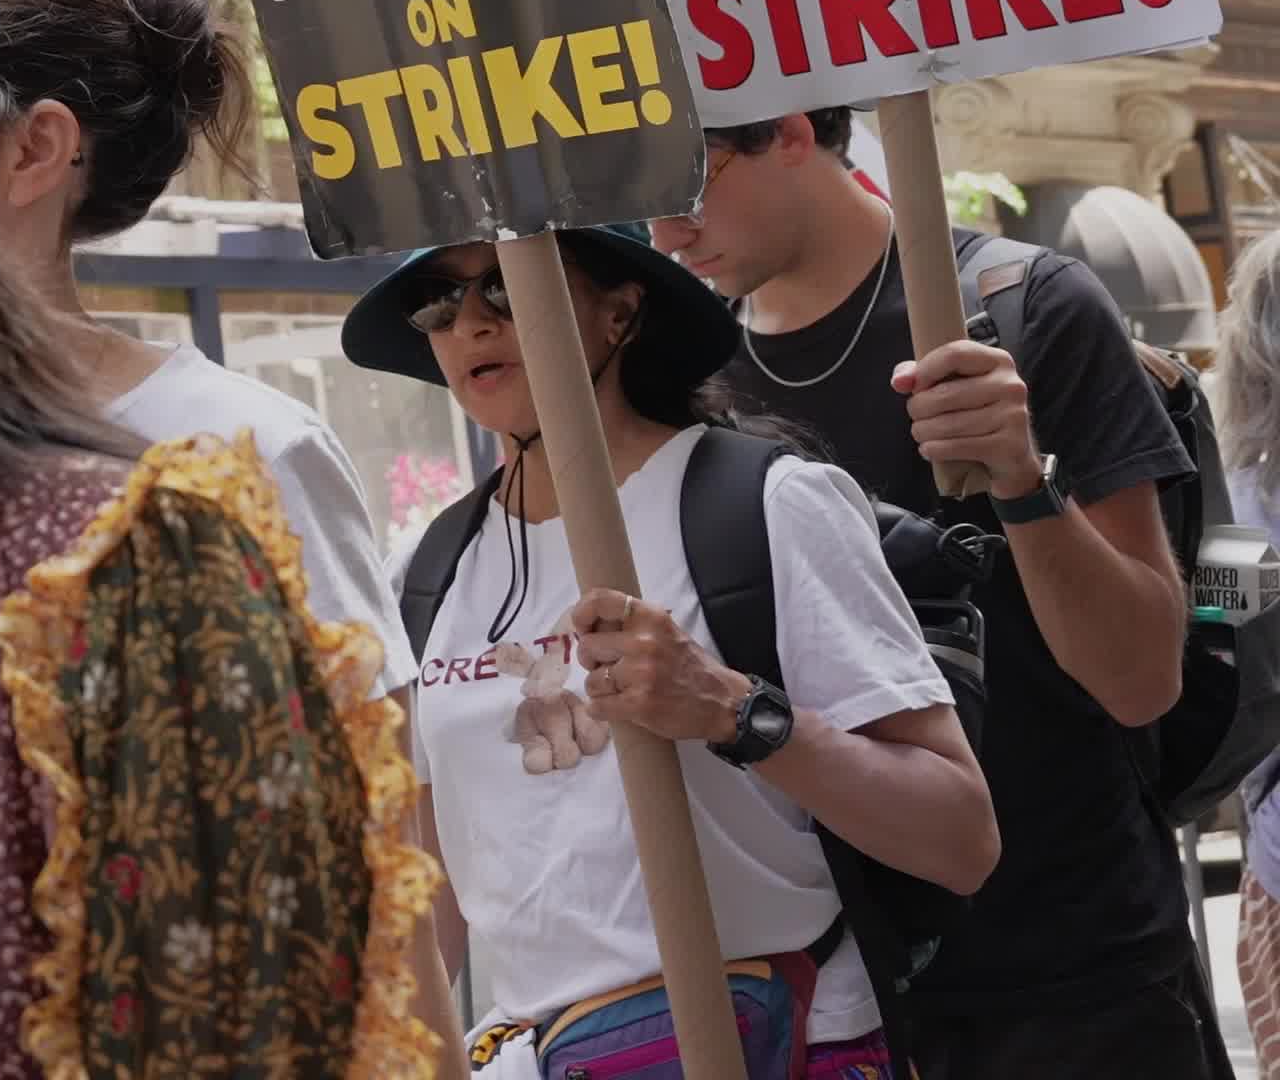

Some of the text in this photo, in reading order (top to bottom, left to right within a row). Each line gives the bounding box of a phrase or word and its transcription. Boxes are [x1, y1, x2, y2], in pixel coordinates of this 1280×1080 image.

[296, 20, 673, 181] STRIKE!
[1194, 566, 1238, 588] BOXED
[1194, 588, 1239, 610] WATER
